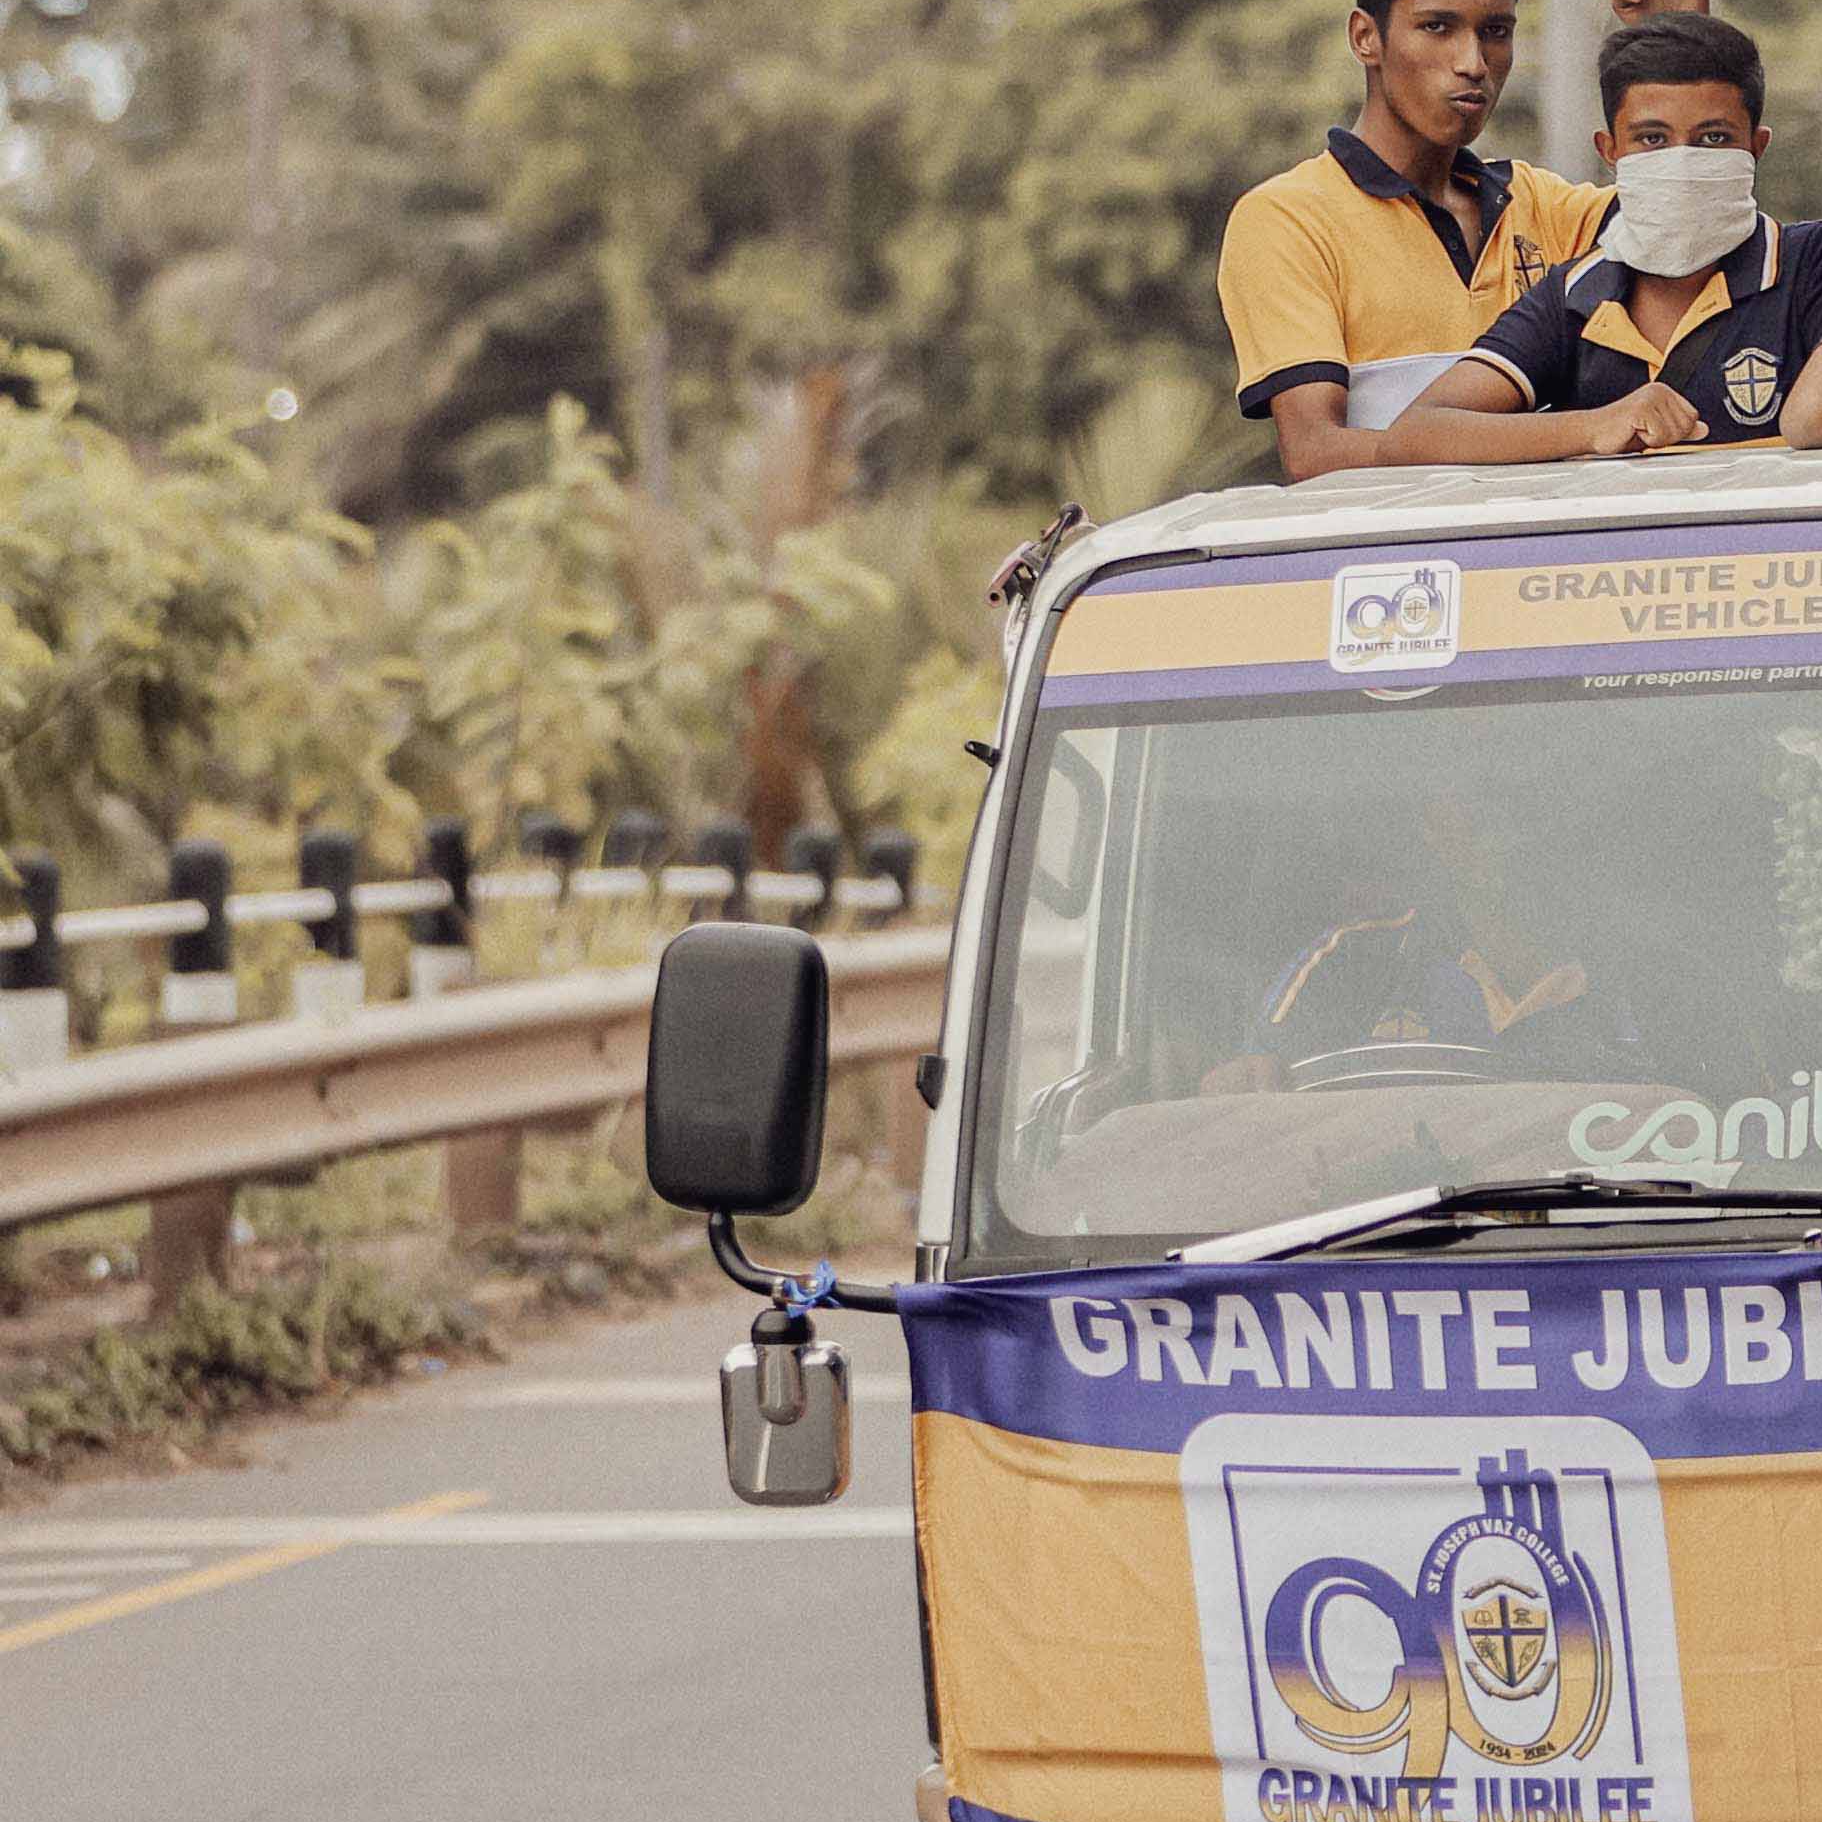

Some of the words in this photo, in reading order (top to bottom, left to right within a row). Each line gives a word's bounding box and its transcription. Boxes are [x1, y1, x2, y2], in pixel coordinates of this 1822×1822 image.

[1519, 563, 1736, 603] GRANITE
[1583, 671, 1631, 690] Your
[1635, 667, 1764, 688] responsible
[1049, 1289, 1538, 1390] GRANITE
[1484, 1518, 1515, 1536] VAZ
[1516, 1524, 1570, 1587] COLLEGE
